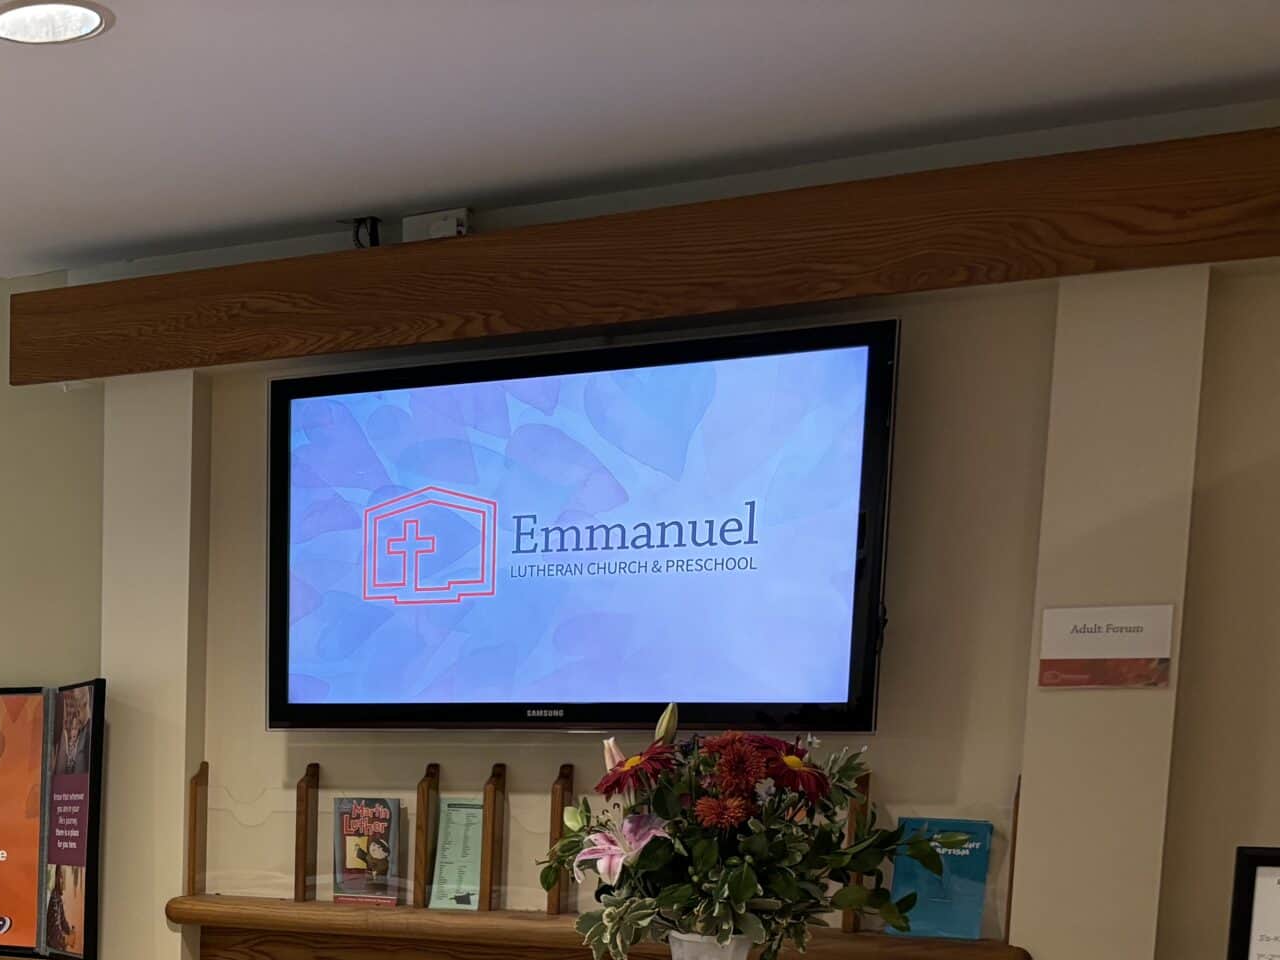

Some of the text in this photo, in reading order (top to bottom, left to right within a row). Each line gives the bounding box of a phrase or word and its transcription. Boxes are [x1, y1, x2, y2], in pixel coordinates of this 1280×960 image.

[511, 500, 758, 554] Emmanuel
[510, 556, 758, 578] LUTHERAN CHURCH & PRESCHOOL
[1070, 623, 1144, 634] Adult Forum
[527, 709, 564, 717] SAMSUNG
[352, 800, 390, 820] Martin
[343, 815, 388, 836] Luther
